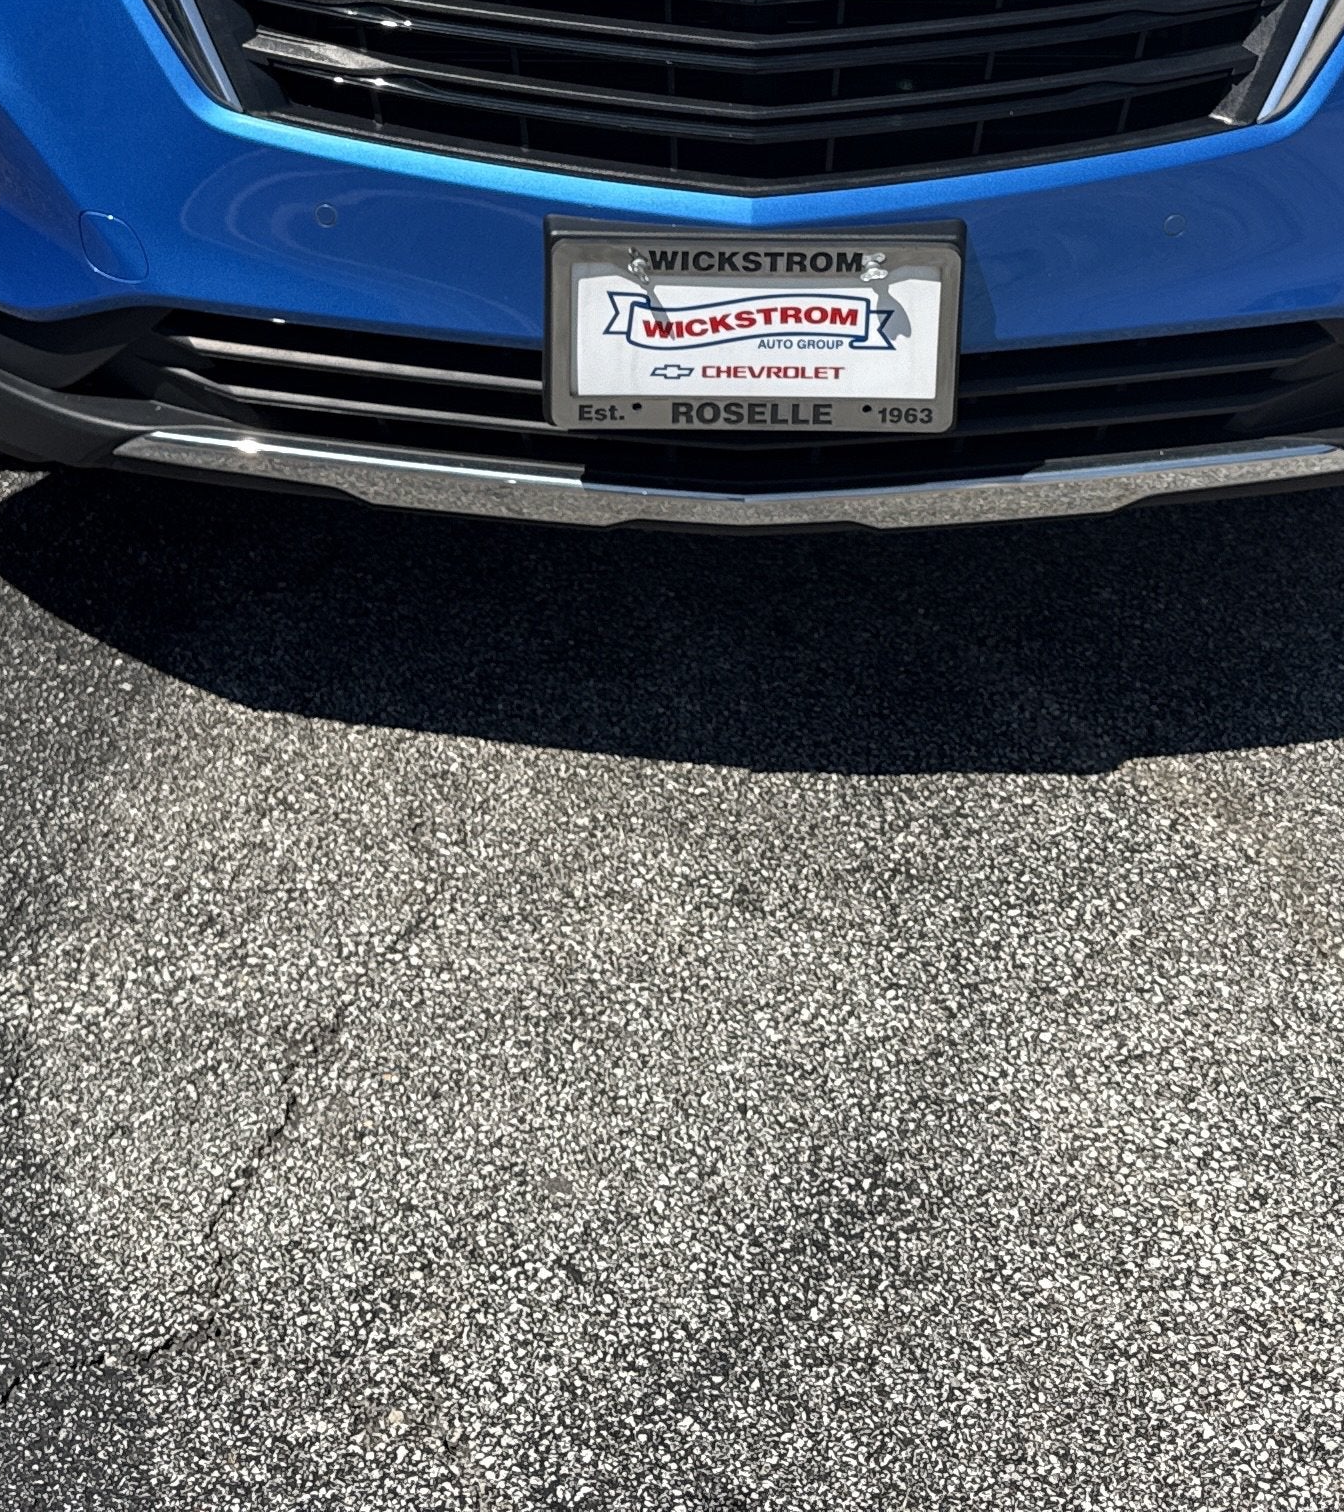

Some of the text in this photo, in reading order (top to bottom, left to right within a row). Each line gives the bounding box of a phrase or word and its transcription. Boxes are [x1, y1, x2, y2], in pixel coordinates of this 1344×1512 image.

[649, 249, 864, 274] WICKSTROM
[642, 305, 859, 339] WICKSTROM
[757, 337, 844, 350] AUTO GROUP
[702, 365, 846, 380] CHEVROLET
[578, 402, 934, 425] Est. ROSELLE 1963
